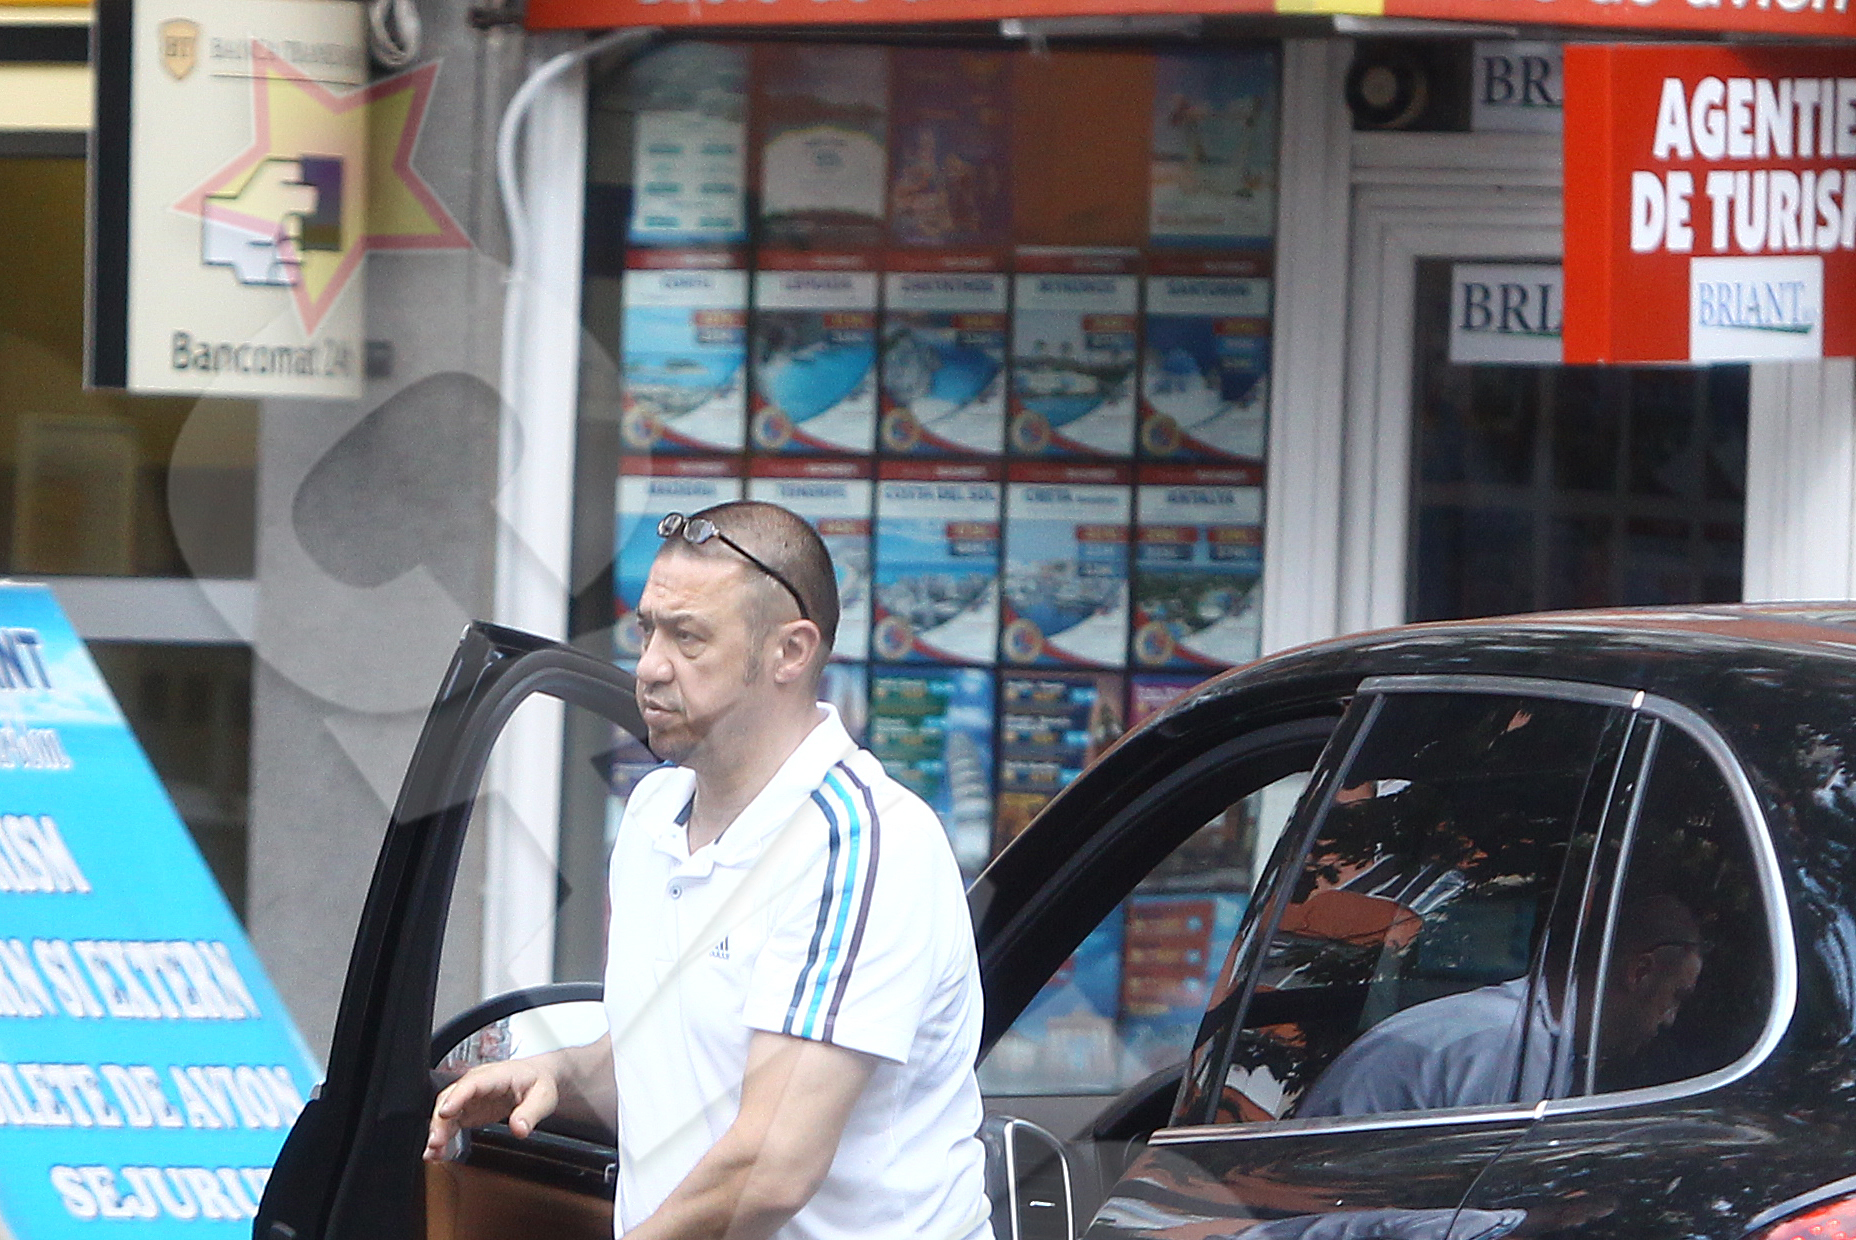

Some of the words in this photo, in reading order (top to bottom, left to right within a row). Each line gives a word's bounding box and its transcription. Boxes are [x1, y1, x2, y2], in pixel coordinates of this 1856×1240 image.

[1652, 75, 1856, 161] AGENTIE
[1630, 169, 1695, 253] DE
[1459, 283, 1562, 332] BRI
[1699, 281, 1804, 326] BRIANT
